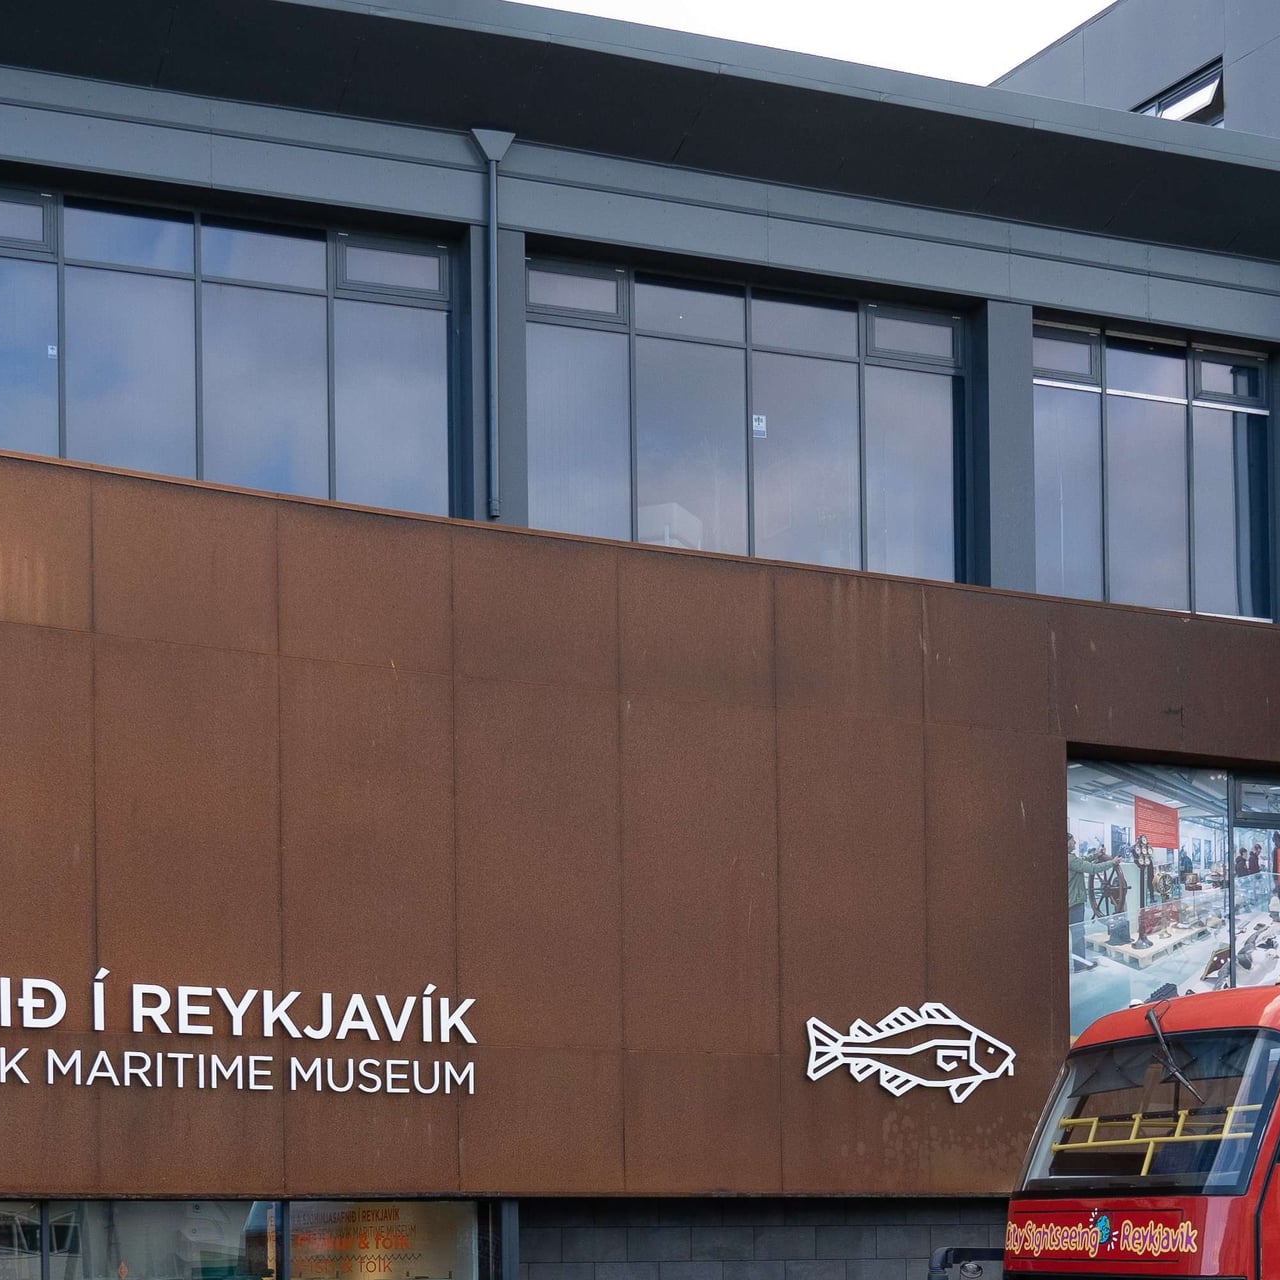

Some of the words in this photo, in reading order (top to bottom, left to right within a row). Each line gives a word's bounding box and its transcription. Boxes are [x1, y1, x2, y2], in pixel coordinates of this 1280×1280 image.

[93, 967, 111, 1031] Í
[131, 983, 478, 1045] REYKJAVÍK
[46, 1049, 274, 1091] MARITIME
[290, 1057, 476, 1095] MUSEUM
[1121, 1219, 1198, 1257] Reykjavik
